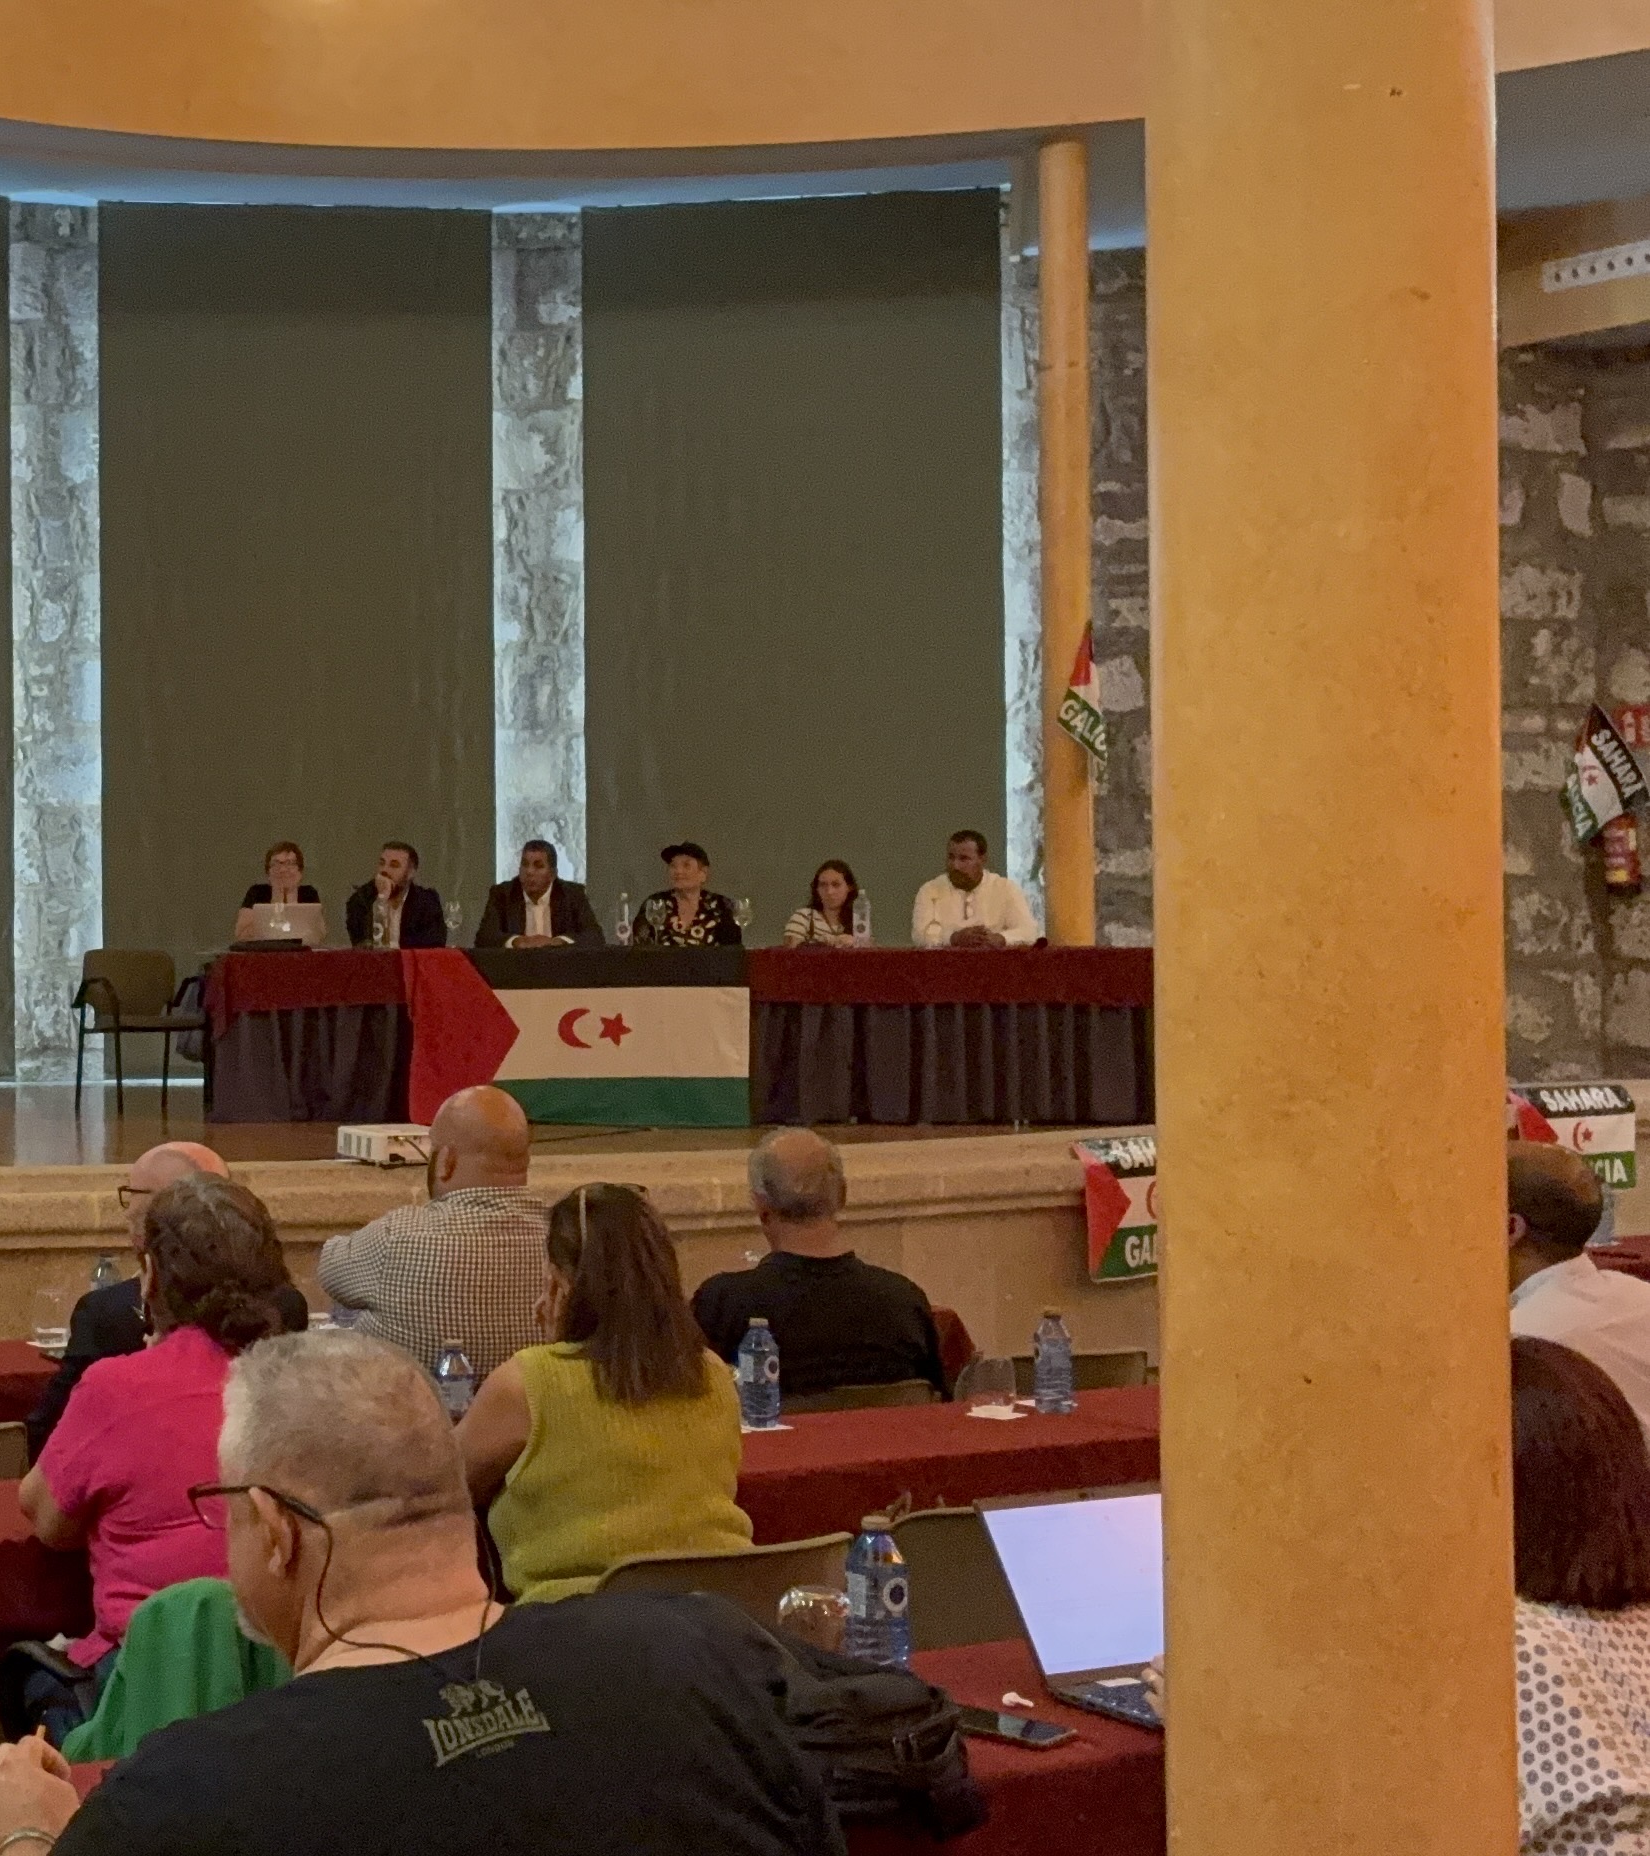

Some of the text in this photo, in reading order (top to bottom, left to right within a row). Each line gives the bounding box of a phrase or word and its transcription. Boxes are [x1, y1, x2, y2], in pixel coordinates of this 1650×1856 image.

[1591, 729, 1642, 799] SAHARA
[1539, 1087, 1626, 1112] SAHARA
[422, 1687, 550, 1767] LONSDALE
